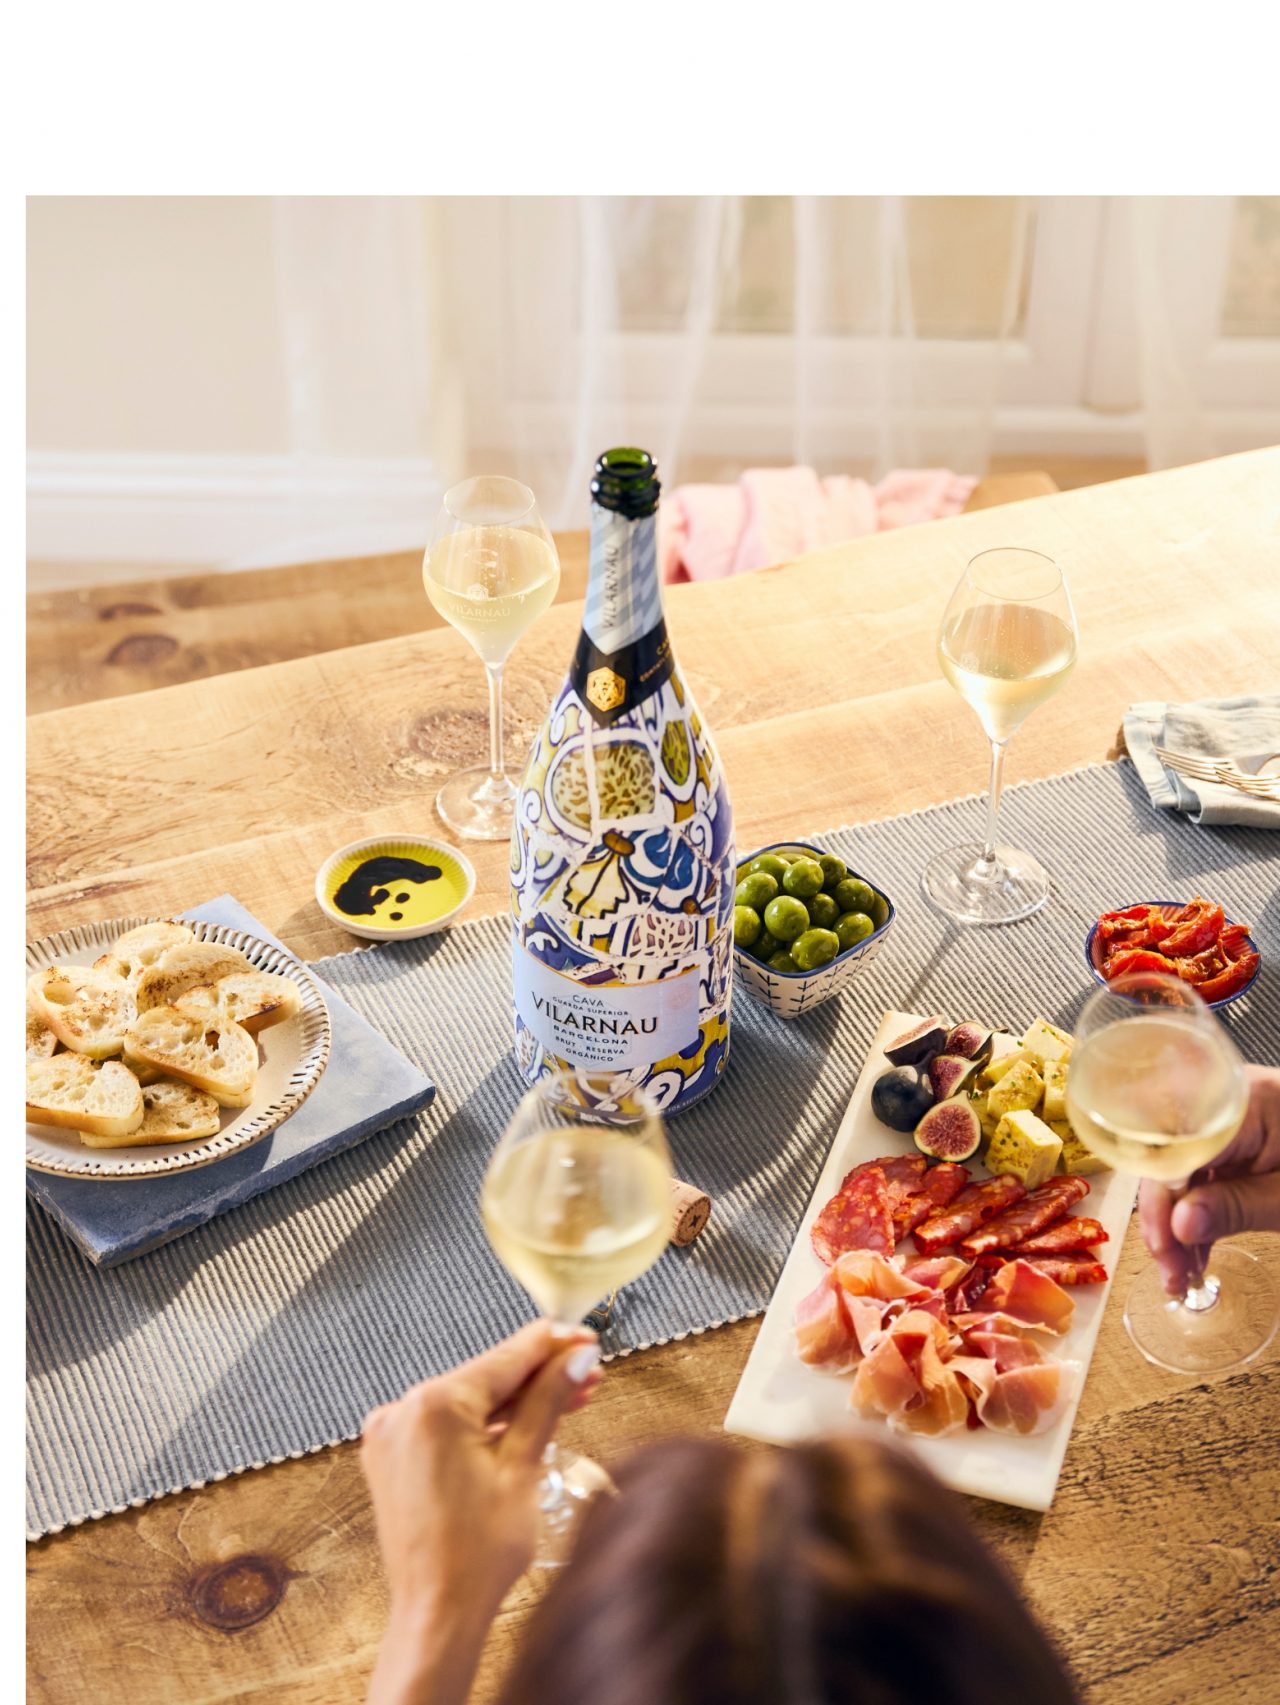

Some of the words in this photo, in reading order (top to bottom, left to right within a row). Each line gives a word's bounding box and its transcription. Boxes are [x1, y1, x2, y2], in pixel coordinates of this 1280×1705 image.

[602, 544, 618, 629] VILARNAU
[572, 994, 605, 1008] CAVA
[531, 991, 658, 1035] VILARNAU
[587, 1007, 629, 1016] SUPERIOR
[553, 1025, 629, 1045] BARCELONA
[555, 1035, 576, 1047] BRUT
[586, 1046, 625, 1055] RESERVA
